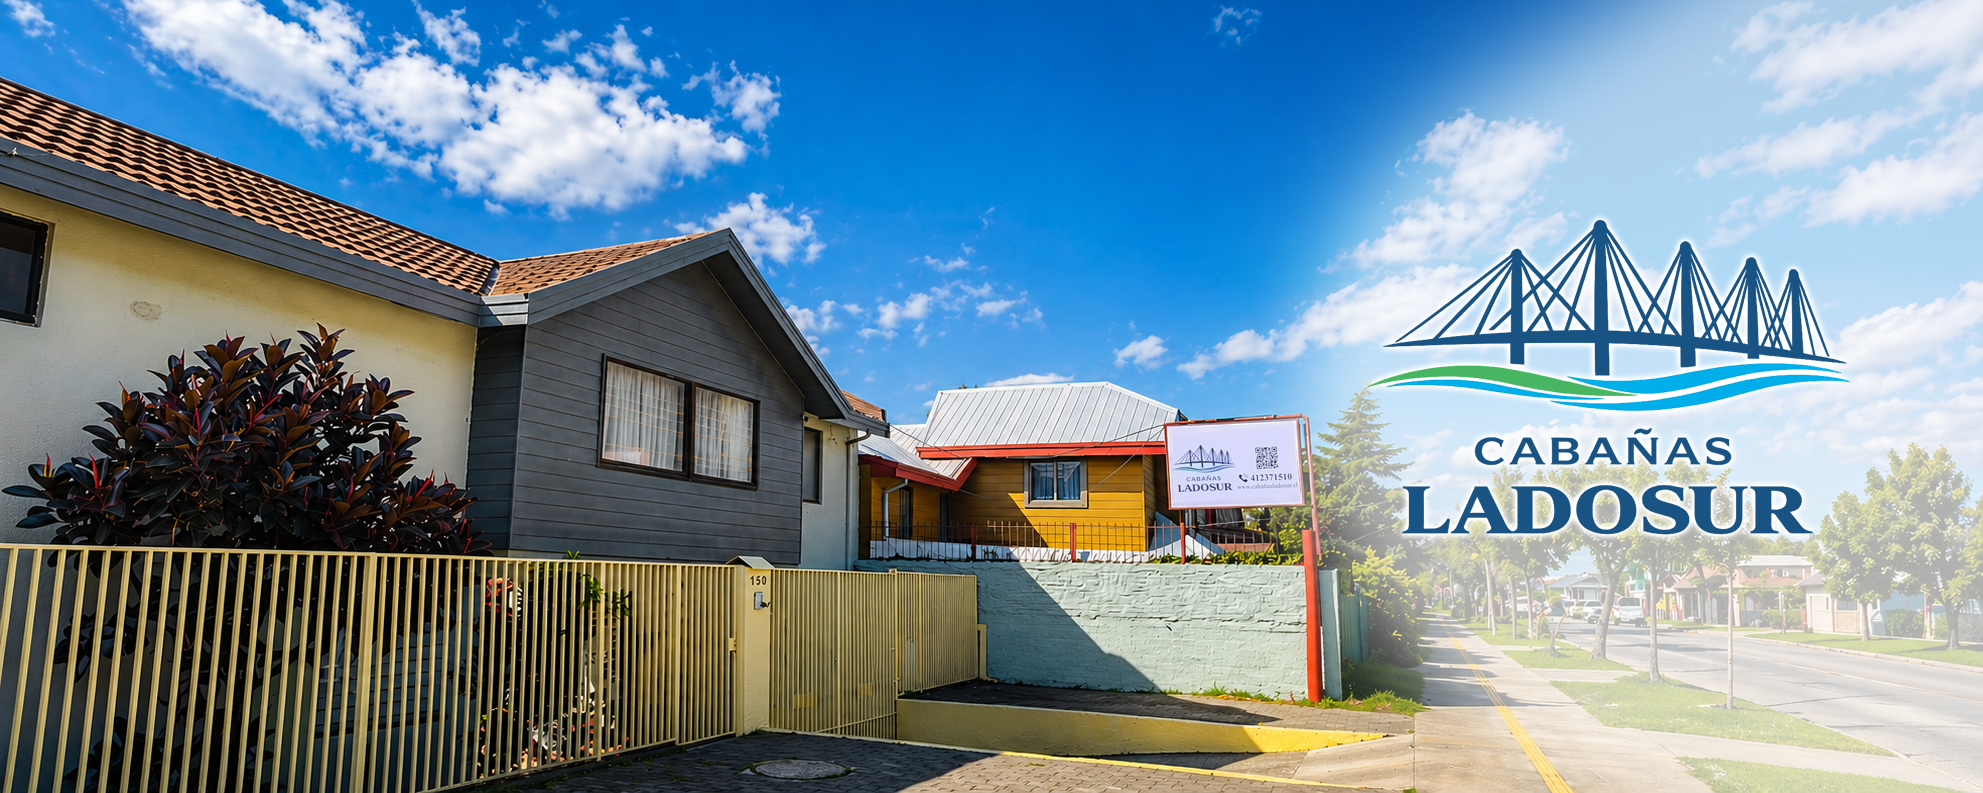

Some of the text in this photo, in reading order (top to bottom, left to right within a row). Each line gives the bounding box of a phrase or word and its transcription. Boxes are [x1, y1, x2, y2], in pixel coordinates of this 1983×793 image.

[1250, 473, 1293, 482] 412371510
[1178, 482, 1233, 493] LADOSUR
[750, 575, 767, 586] 150
